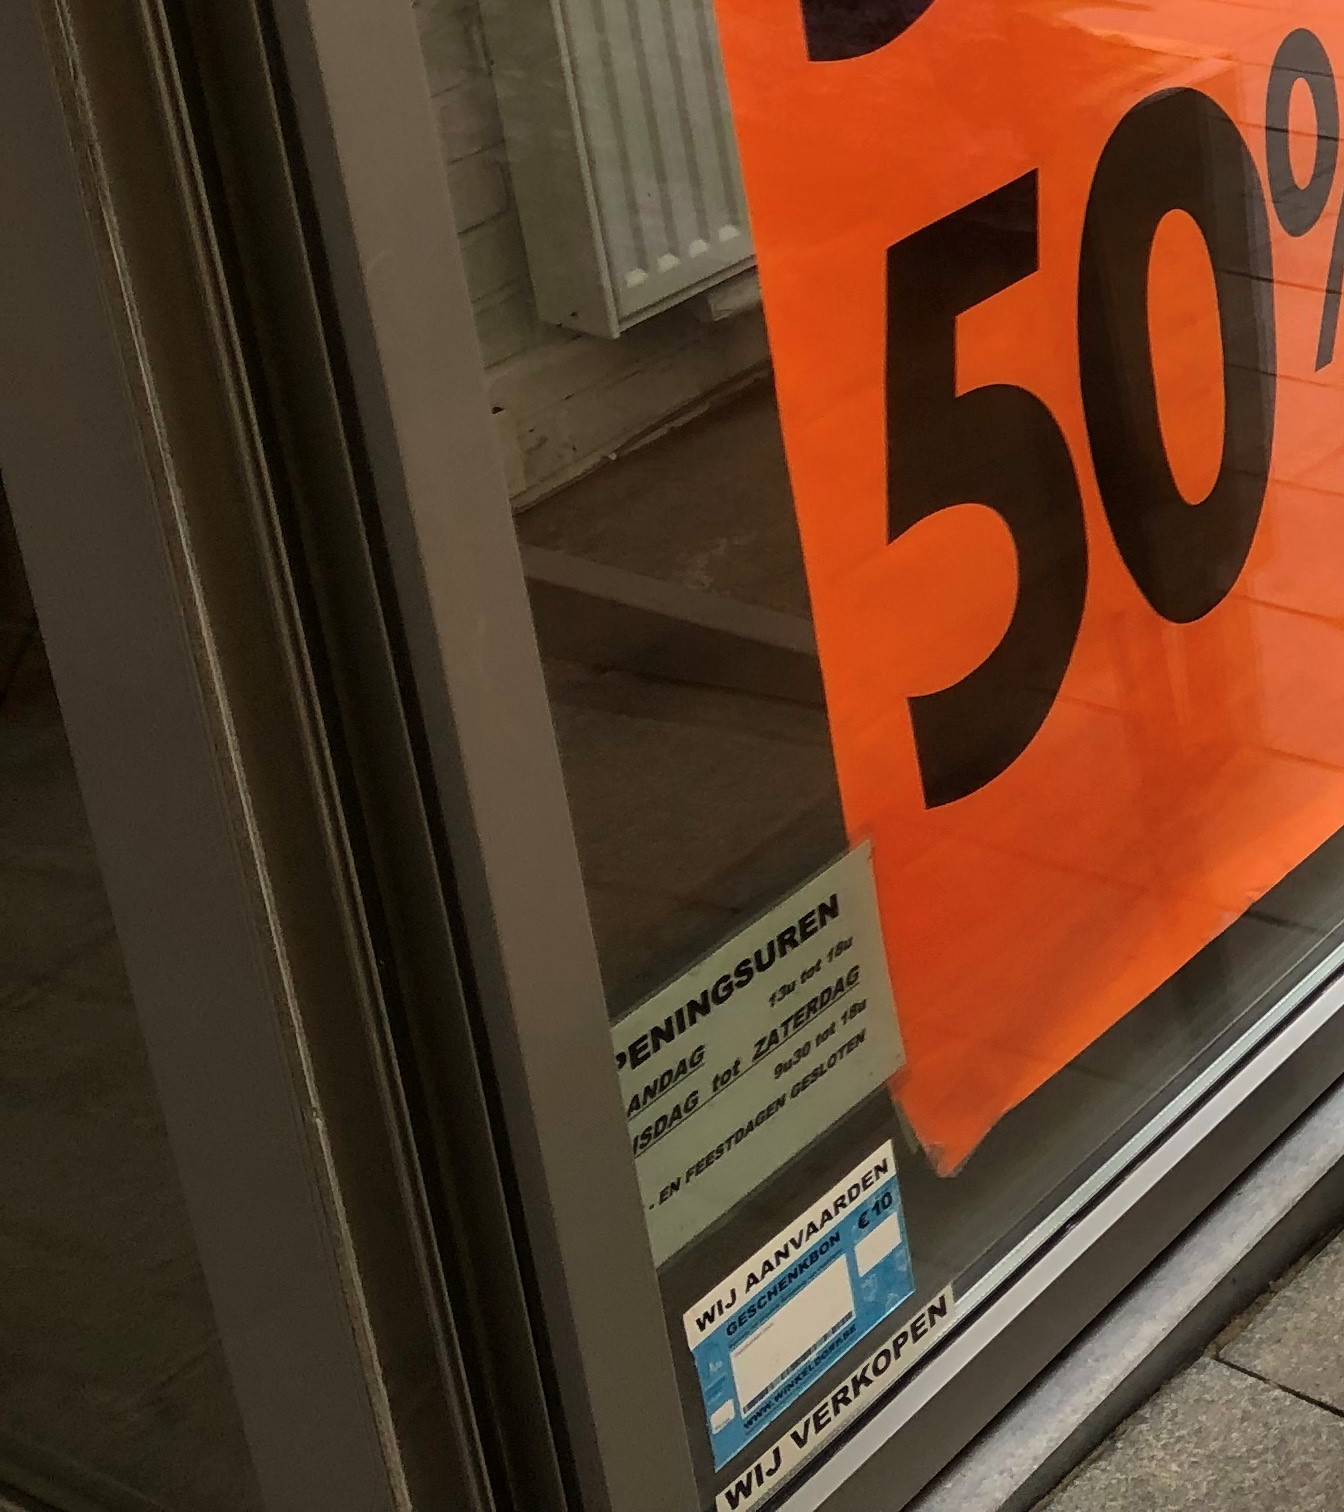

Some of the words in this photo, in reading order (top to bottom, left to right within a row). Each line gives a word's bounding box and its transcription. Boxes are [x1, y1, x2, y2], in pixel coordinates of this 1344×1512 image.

[711, 1055, 742, 1093] tot
[751, 964, 861, 1061] ZATERDAG
[768, 978, 798, 1008] 13u
[799, 958, 822, 984] tot
[773, 1040, 812, 1080] 9u30
[814, 1020, 836, 1048] tot
[658, 1176, 683, 1206] EN
[684, 1092, 787, 1185] FEESTDAGEN
[789, 1027, 867, 1100] GESLOTEN
[694, 1287, 738, 1334] WIJ
[744, 1157, 890, 1296] AANVAARDEN
[856, 1210, 871, 1231] €
[873, 1191, 894, 1218] 10
[725, 1229, 842, 1337] GESCHENKBON
[723, 1444, 783, 1512] WIJ
[789, 1292, 948, 1451] VERKOPEN
